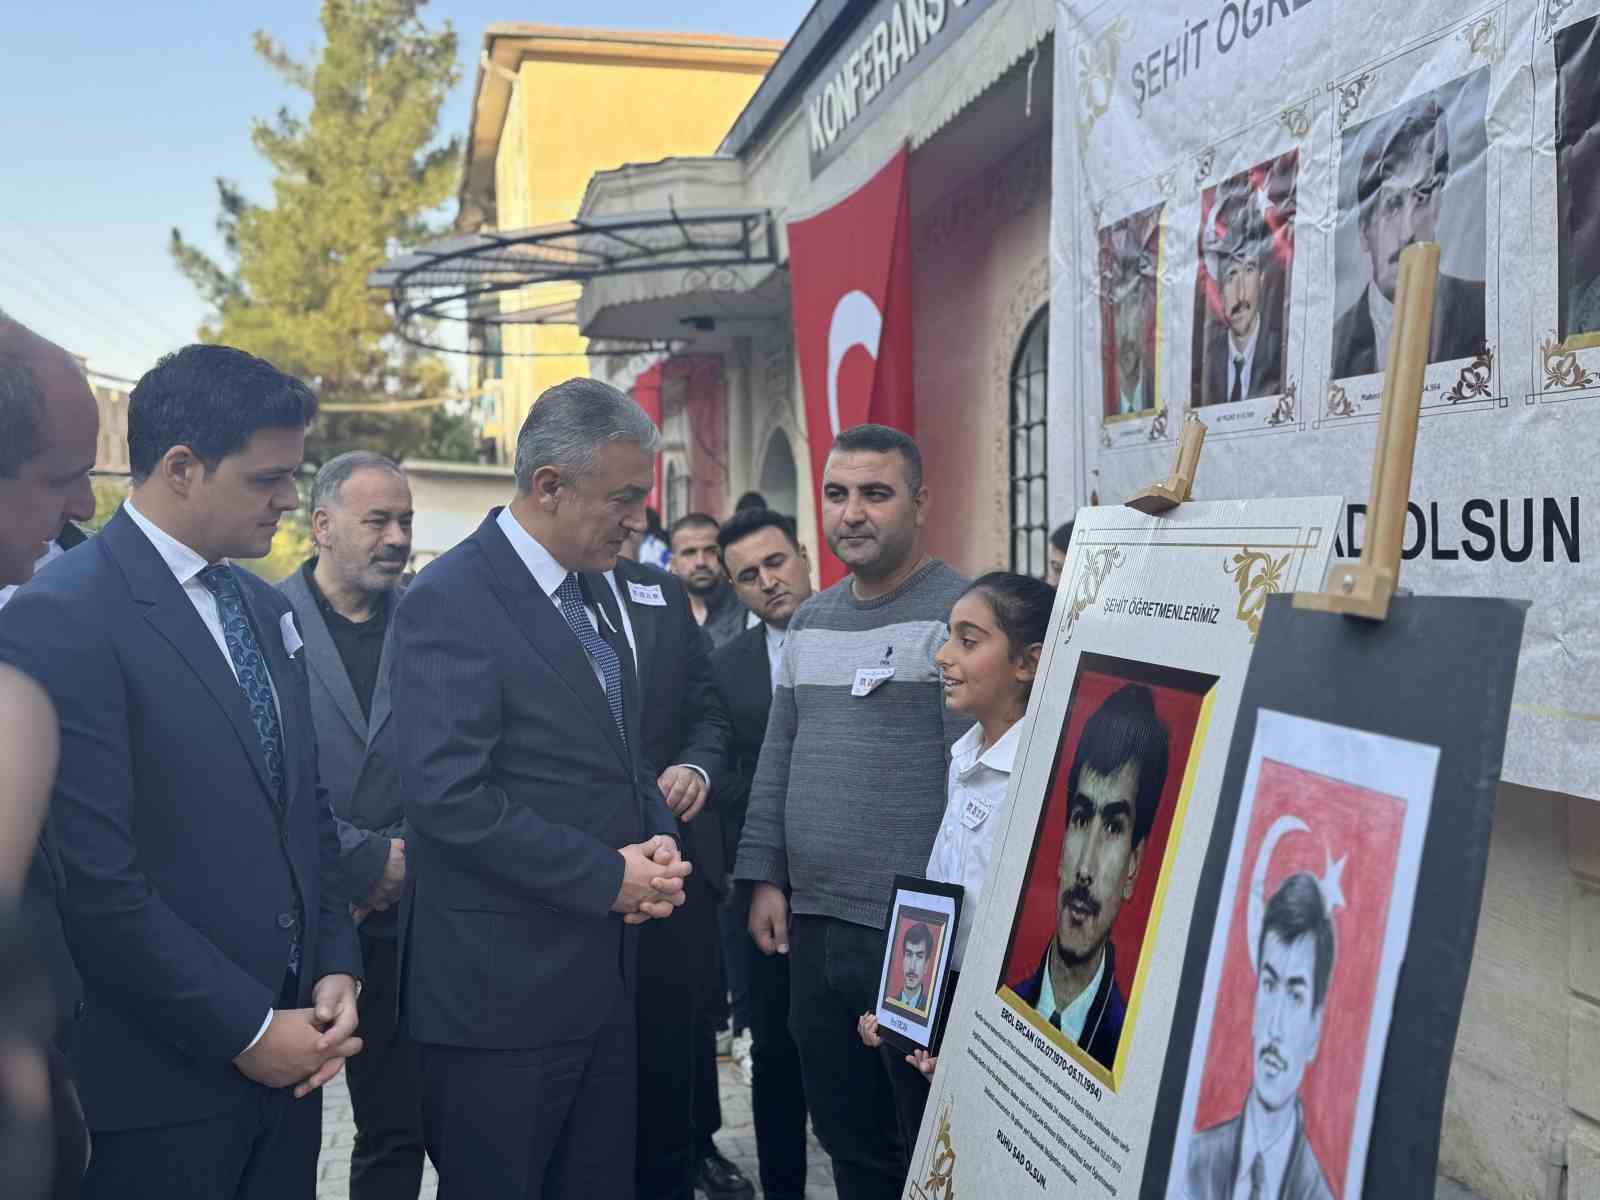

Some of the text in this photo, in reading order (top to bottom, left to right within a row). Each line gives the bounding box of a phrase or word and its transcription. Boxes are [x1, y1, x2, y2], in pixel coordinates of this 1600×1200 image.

[808, 0, 947, 152] KONFERANS
[1131, 19, 1209, 118] ŞEHİT
[1103, 597, 1221, 624] ŞEHİT ÖĞRETMENLERİMİZ
[1001, 1007, 1015, 1027] EROL
[1015, 1020, 1035, 1042] ERCAN
[996, 1129, 1014, 1152] RUHU
[1025, 1160, 1047, 1191] OLSUN.
